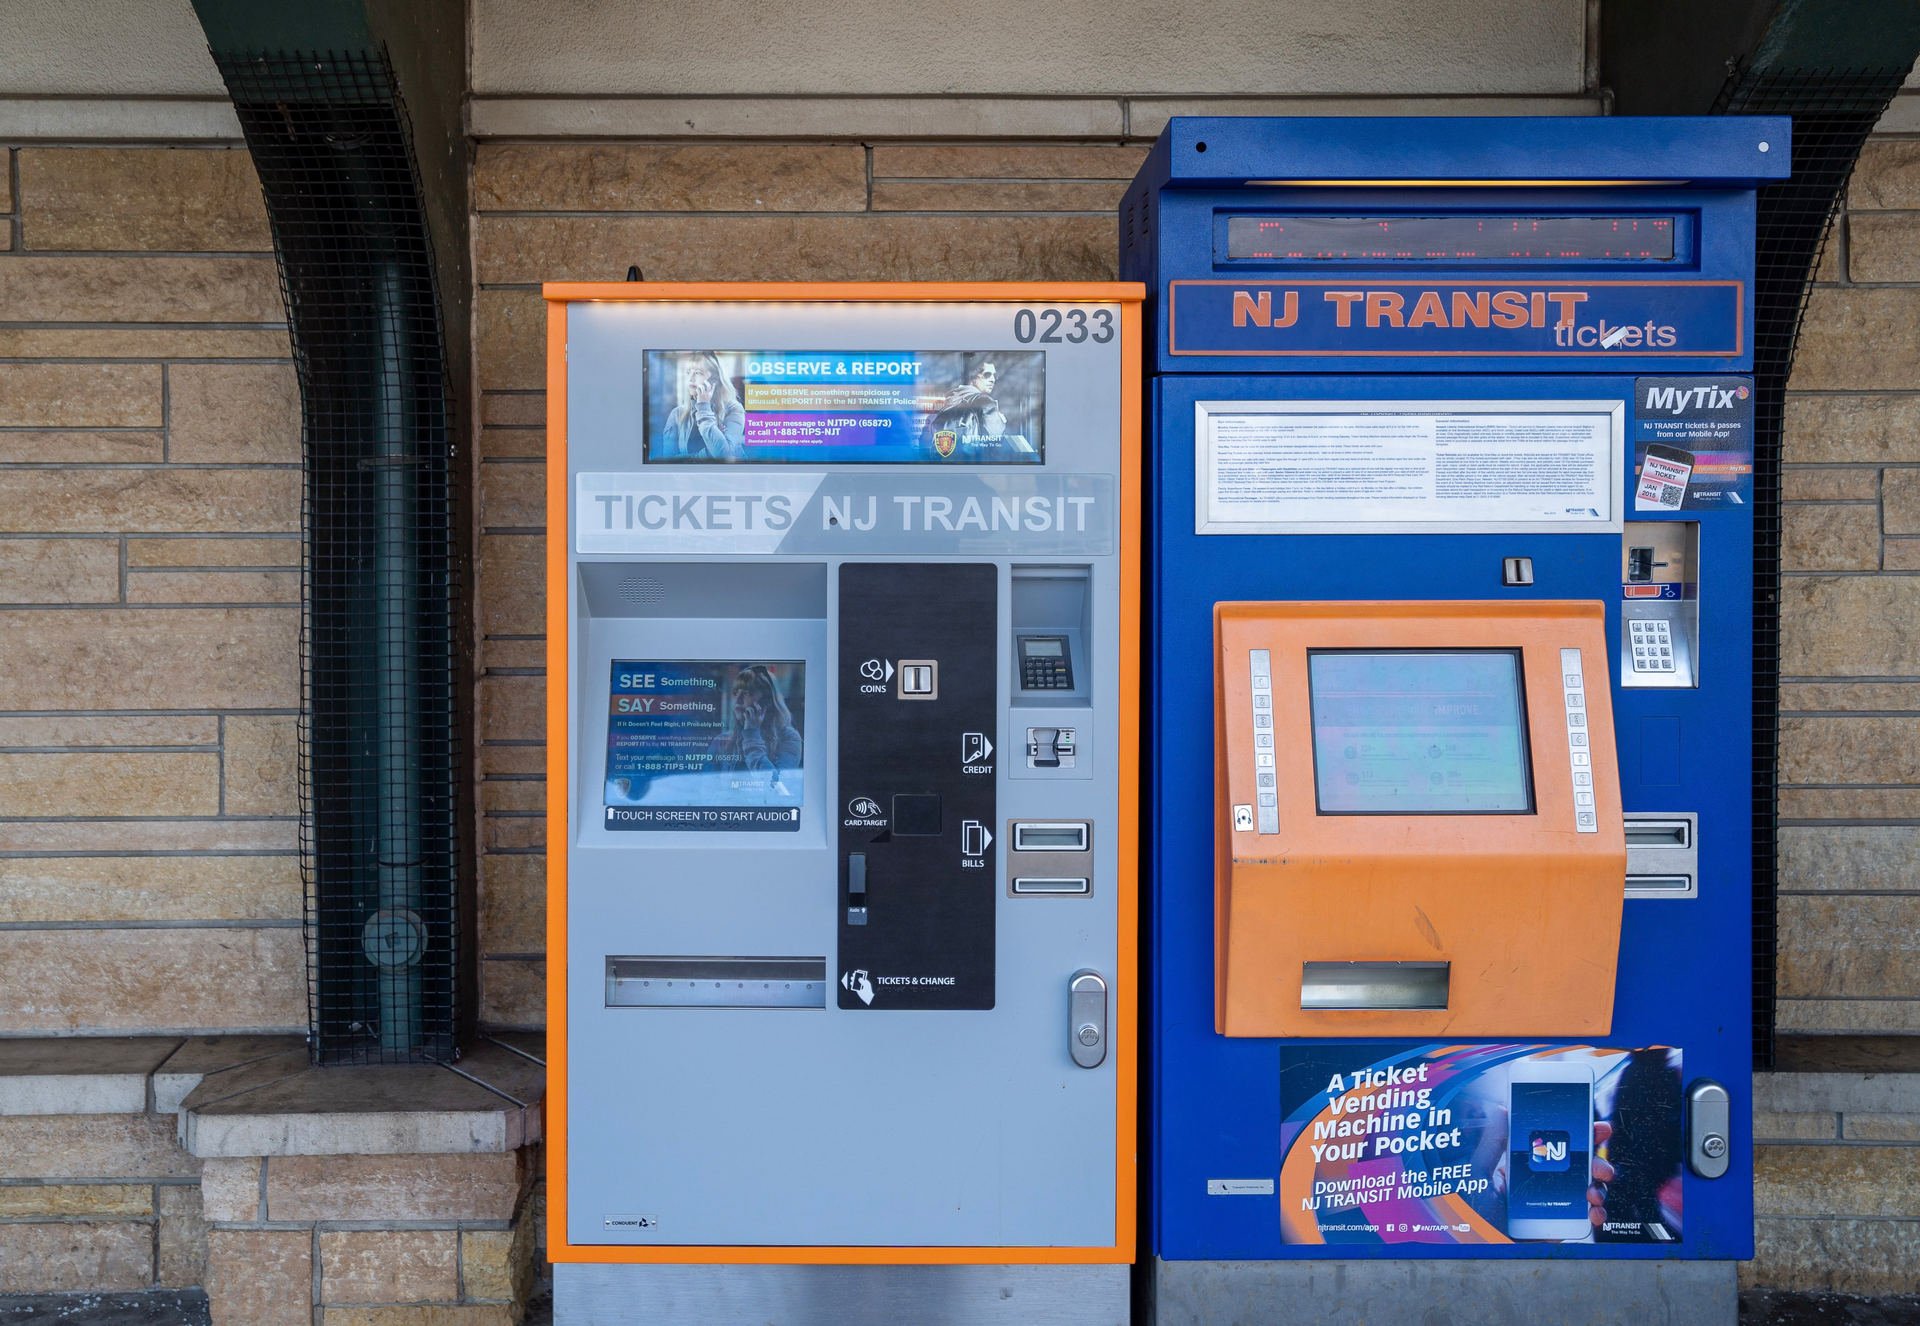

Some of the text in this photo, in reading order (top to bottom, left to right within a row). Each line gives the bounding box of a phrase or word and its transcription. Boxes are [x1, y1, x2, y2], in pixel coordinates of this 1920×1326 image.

[1232, 290, 1588, 328] NJ TRANSIT
[1013, 308, 1115, 344] 0233
[1553, 319, 1677, 349] tickets
[748, 361, 922, 375] OBSERVE & REPORT
[810, 389, 850, 397] something
[852, 389, 890, 397] suspicious
[1645, 385, 1736, 415] MyTix
[858, 418, 892, 428] (65873)
[772, 428, 840, 436] 1-888-TIPS-NJT
[1655, 470, 1676, 480] TICKET
[1660, 464, 1684, 475] TRANSIT
[594, 494, 792, 531] TICKETS
[822, 495, 1096, 532] NJ TRANSIT
[620, 674, 716, 688] SEE Something,
[860, 685, 886, 693] COINS
[618, 698, 716, 712] SAY Something.
[962, 766, 992, 774] CREDIT
[616, 811, 790, 821] TOUCH SCREEN TO START AUDIO
[962, 860, 984, 868] BILLS
[877, 977, 955, 985] TICKETS & CHANGE
[1326, 1062, 1428, 1093] A Ticket
[1329, 1088, 1432, 1115] Vending
[1314, 1106, 1451, 1141] Machine in
[1310, 1128, 1461, 1163] Your Pocket
[1315, 1164, 1472, 1194] Download the FREE
[1302, 1178, 1488, 1211] NJ TRANSIT Mobile App
[1317, 1224, 1380, 1232] njtransit.com/app
